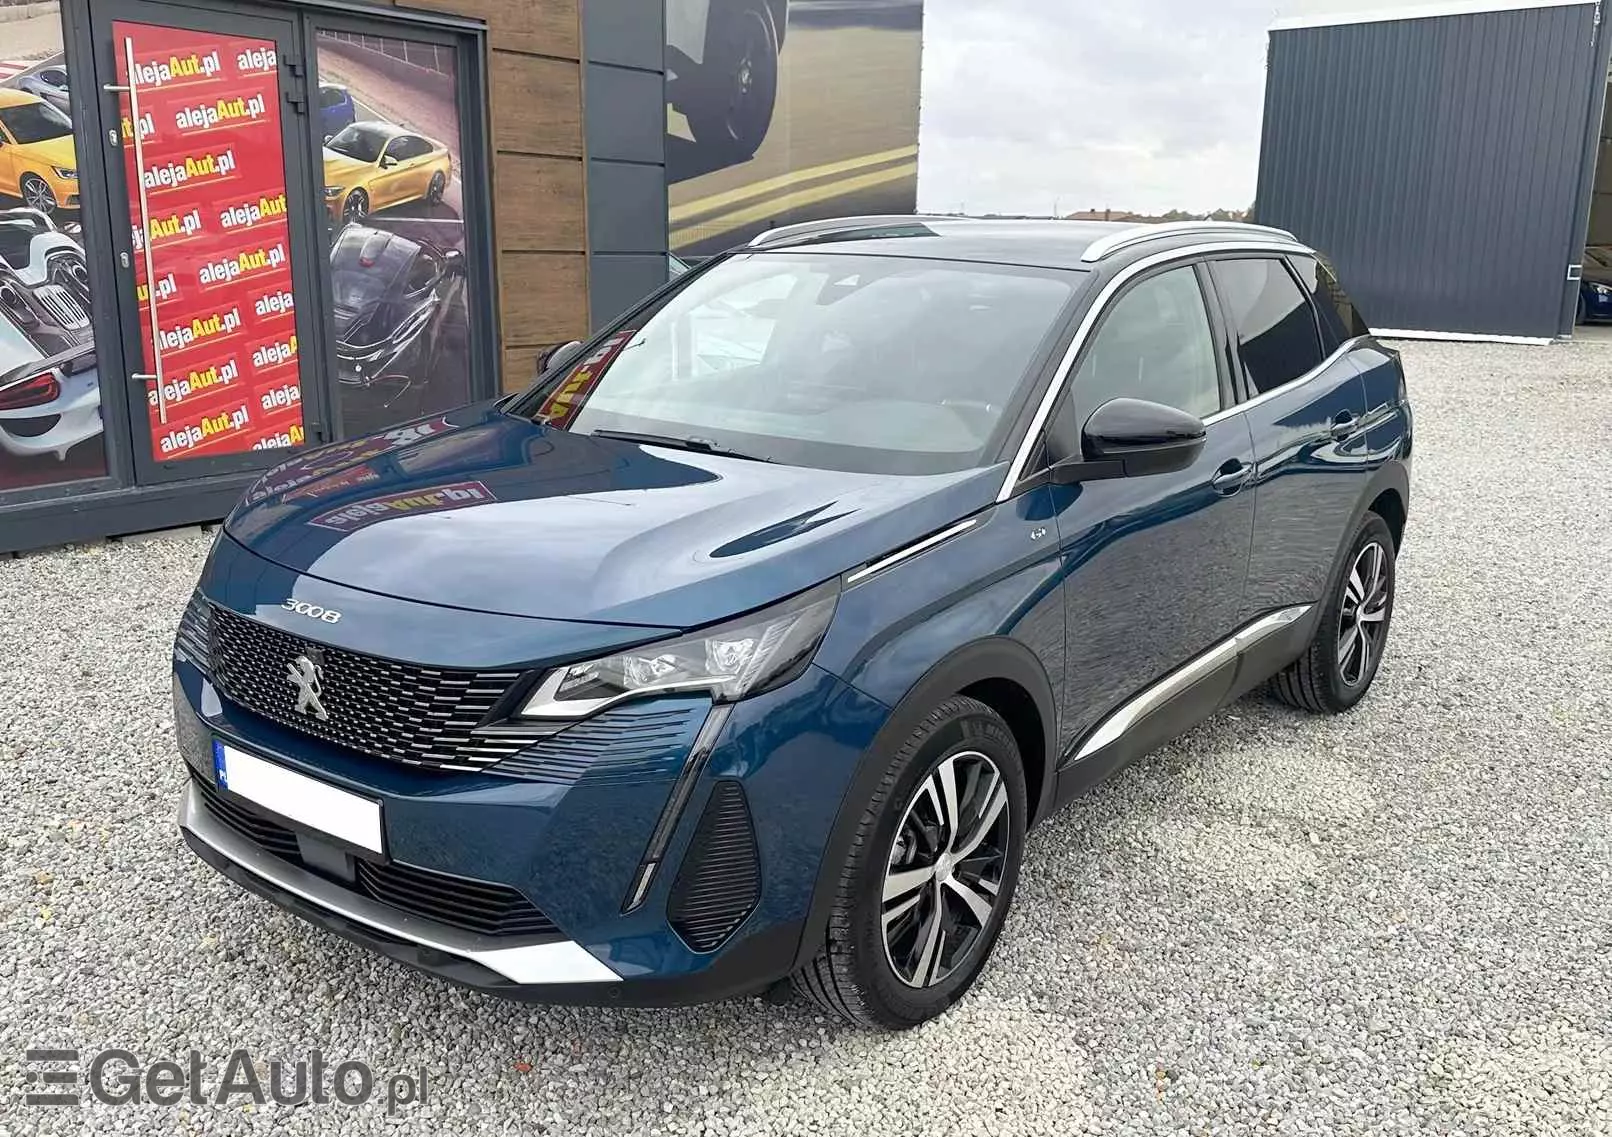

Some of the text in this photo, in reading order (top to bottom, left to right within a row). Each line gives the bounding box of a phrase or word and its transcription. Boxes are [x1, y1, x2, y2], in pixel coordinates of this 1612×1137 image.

[127, 50, 221, 86] lejaAut.pl
[175, 93, 265, 128] alejaAut.pl
[144, 150, 236, 188] alejaAut.pl
[199, 243, 286, 284] alejaAut.pl
[151, 307, 241, 351] lejaAut.pl
[148, 360, 239, 405] aejaAut.pl
[160, 405, 250, 453] alejaAut.pl
[281, 597, 343, 624] 3008
